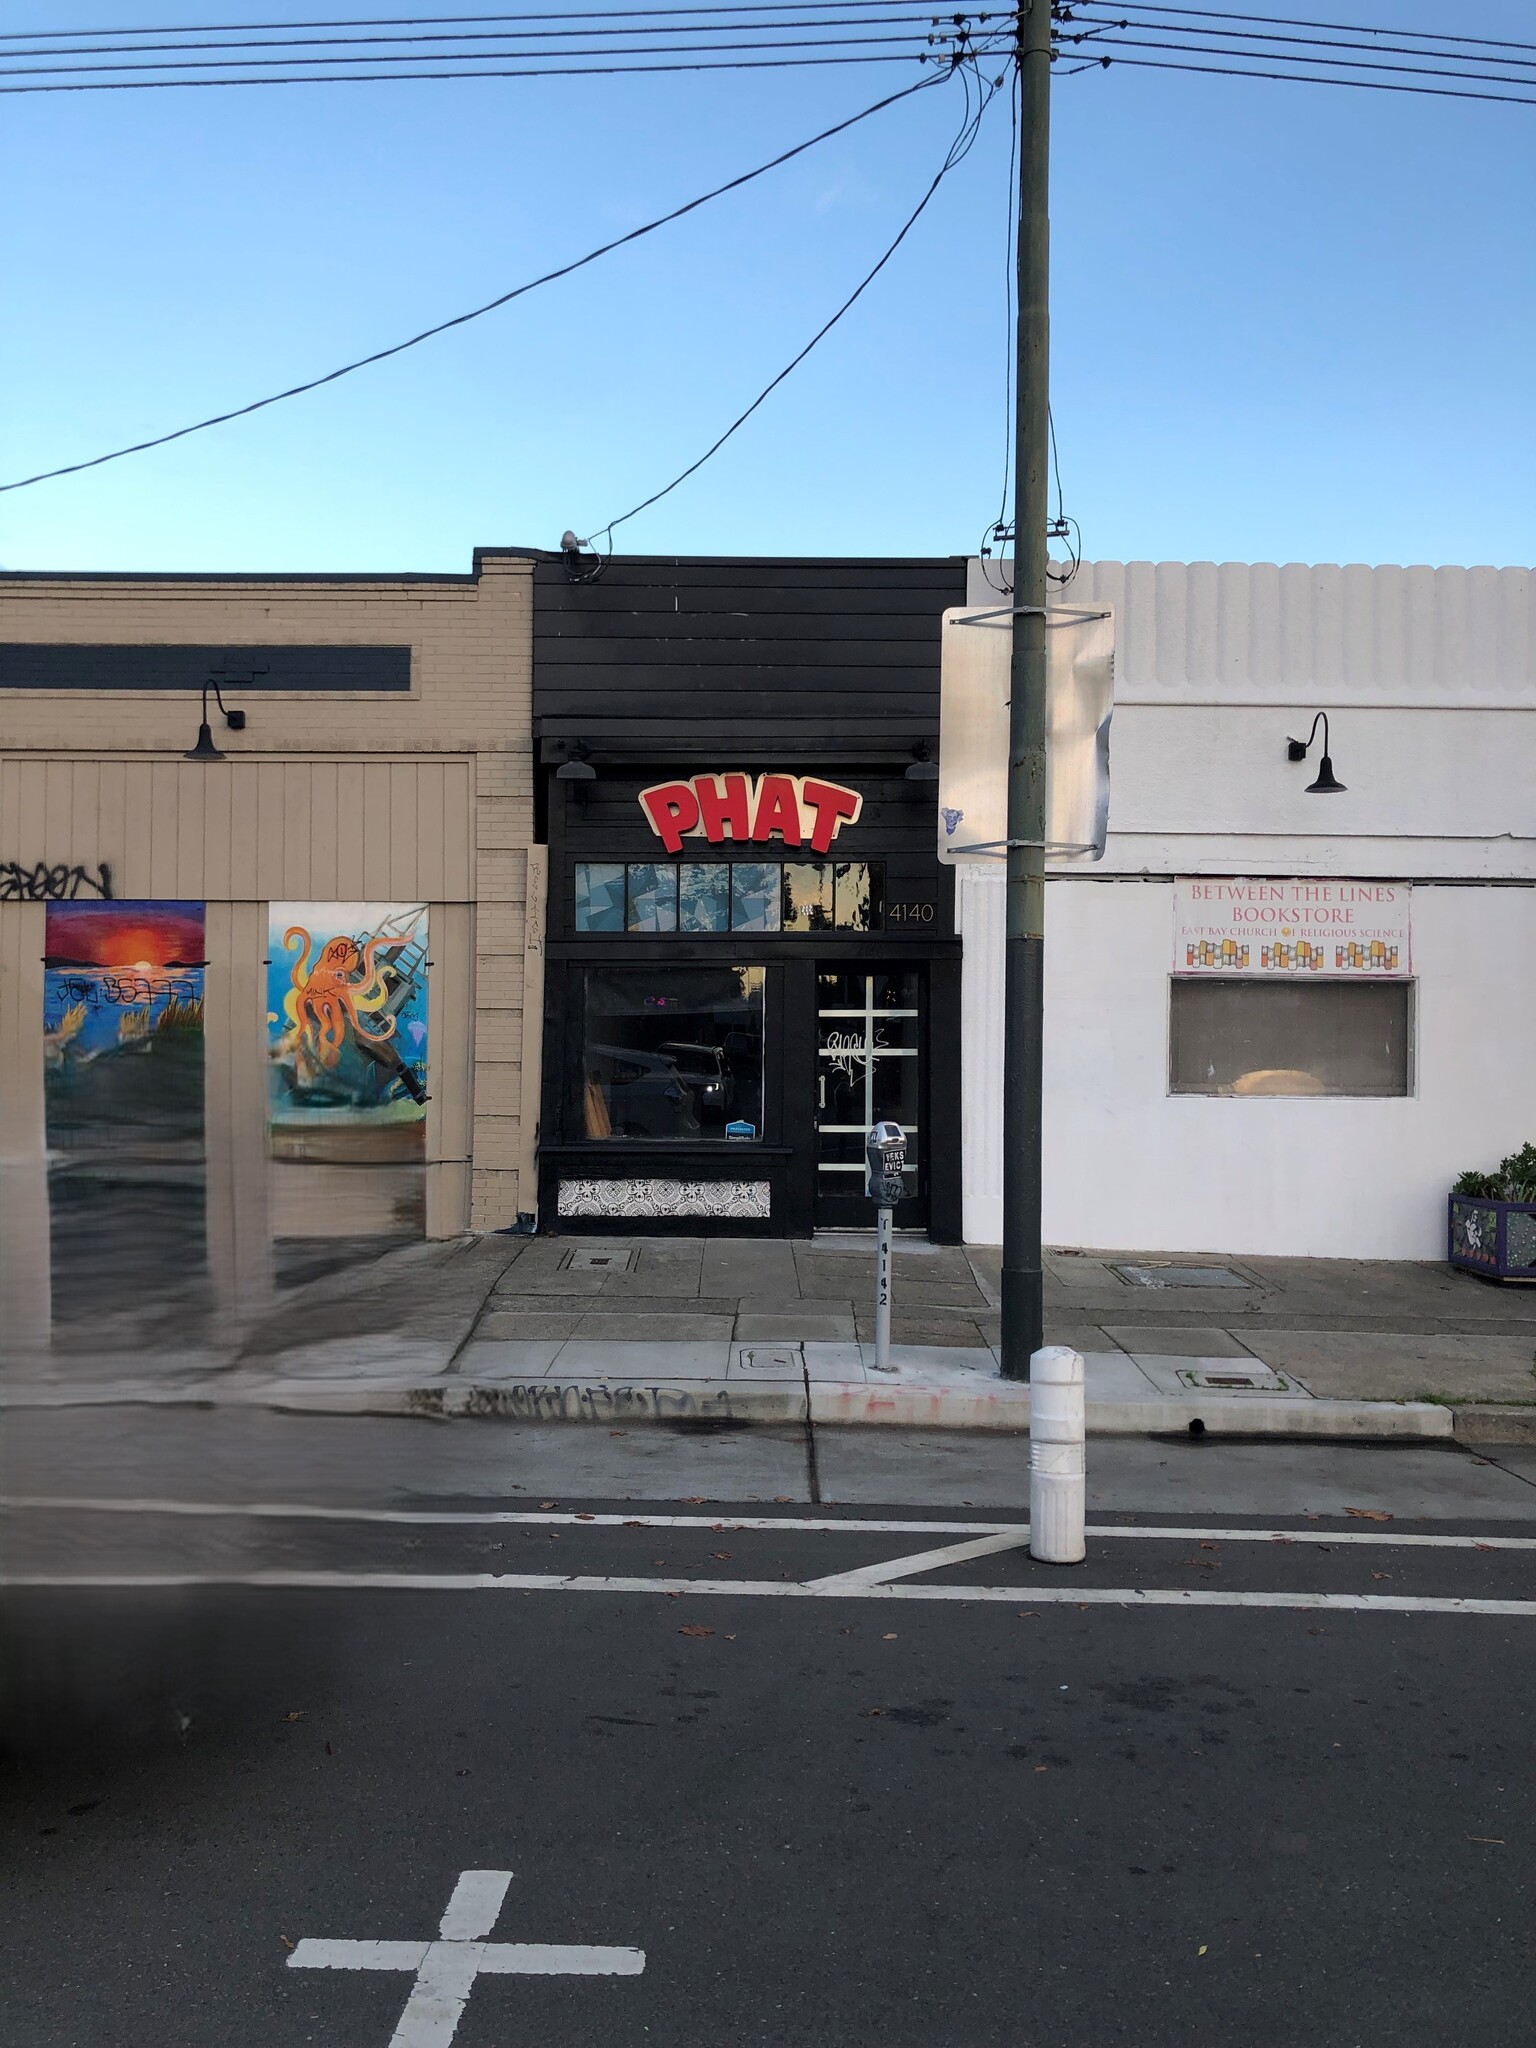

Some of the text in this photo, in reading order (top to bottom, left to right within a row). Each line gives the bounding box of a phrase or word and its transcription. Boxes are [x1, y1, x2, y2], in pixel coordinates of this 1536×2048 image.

[641, 774, 860, 855] PHAT
[1191, 884, 1396, 902] BETWEEN THE LINES
[889, 903, 934, 922] 4140
[1232, 906, 1355, 924] BOOKSTORE
[1181, 926, 1205, 936] EAST
[1208, 927, 1228, 936] BAY
[1230, 927, 1277, 937] CHURCH
[1300, 928, 1357, 938] RELIGIOUS
[1360, 929, 1404, 938] SCIENCE
[884, 1160, 904, 1171] EVICT
